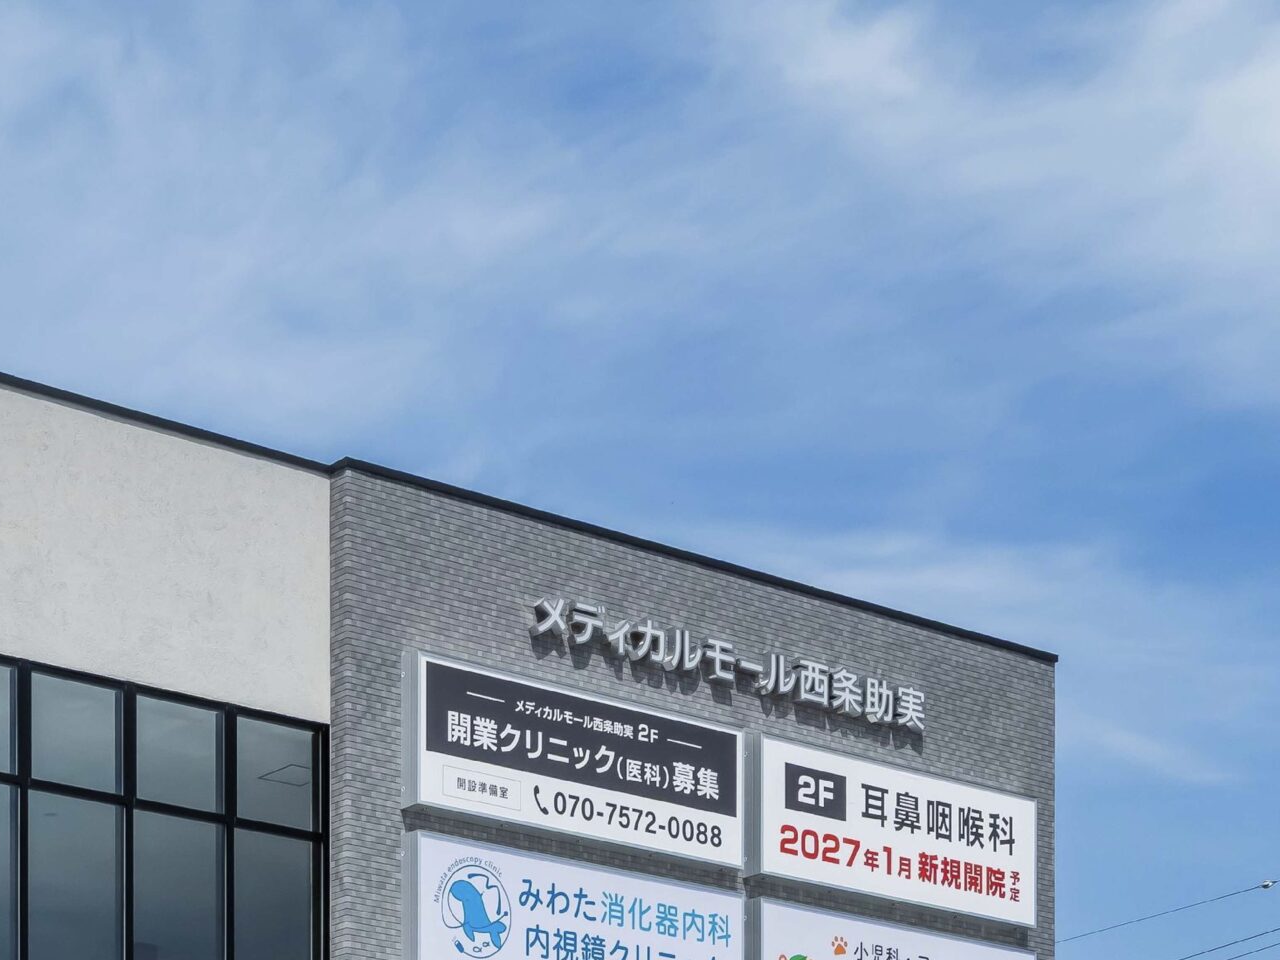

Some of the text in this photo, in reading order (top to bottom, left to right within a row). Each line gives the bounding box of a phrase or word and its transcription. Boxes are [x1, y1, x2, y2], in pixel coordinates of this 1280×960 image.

[534, 597, 926, 731] メディカルモール西条助実
[515, 699, 659, 744] メディカルモール西条助実 2F
[456, 776, 509, 800] 開設準備室
[797, 774, 1016, 856] 2F 耳鼻咽喉科
[553, 791, 723, 848] 070-7572-0088
[447, 856, 483, 873] endoscopy
[484, 860, 503, 878] clinic
[518, 878, 732, 948] みわた消化器内科
